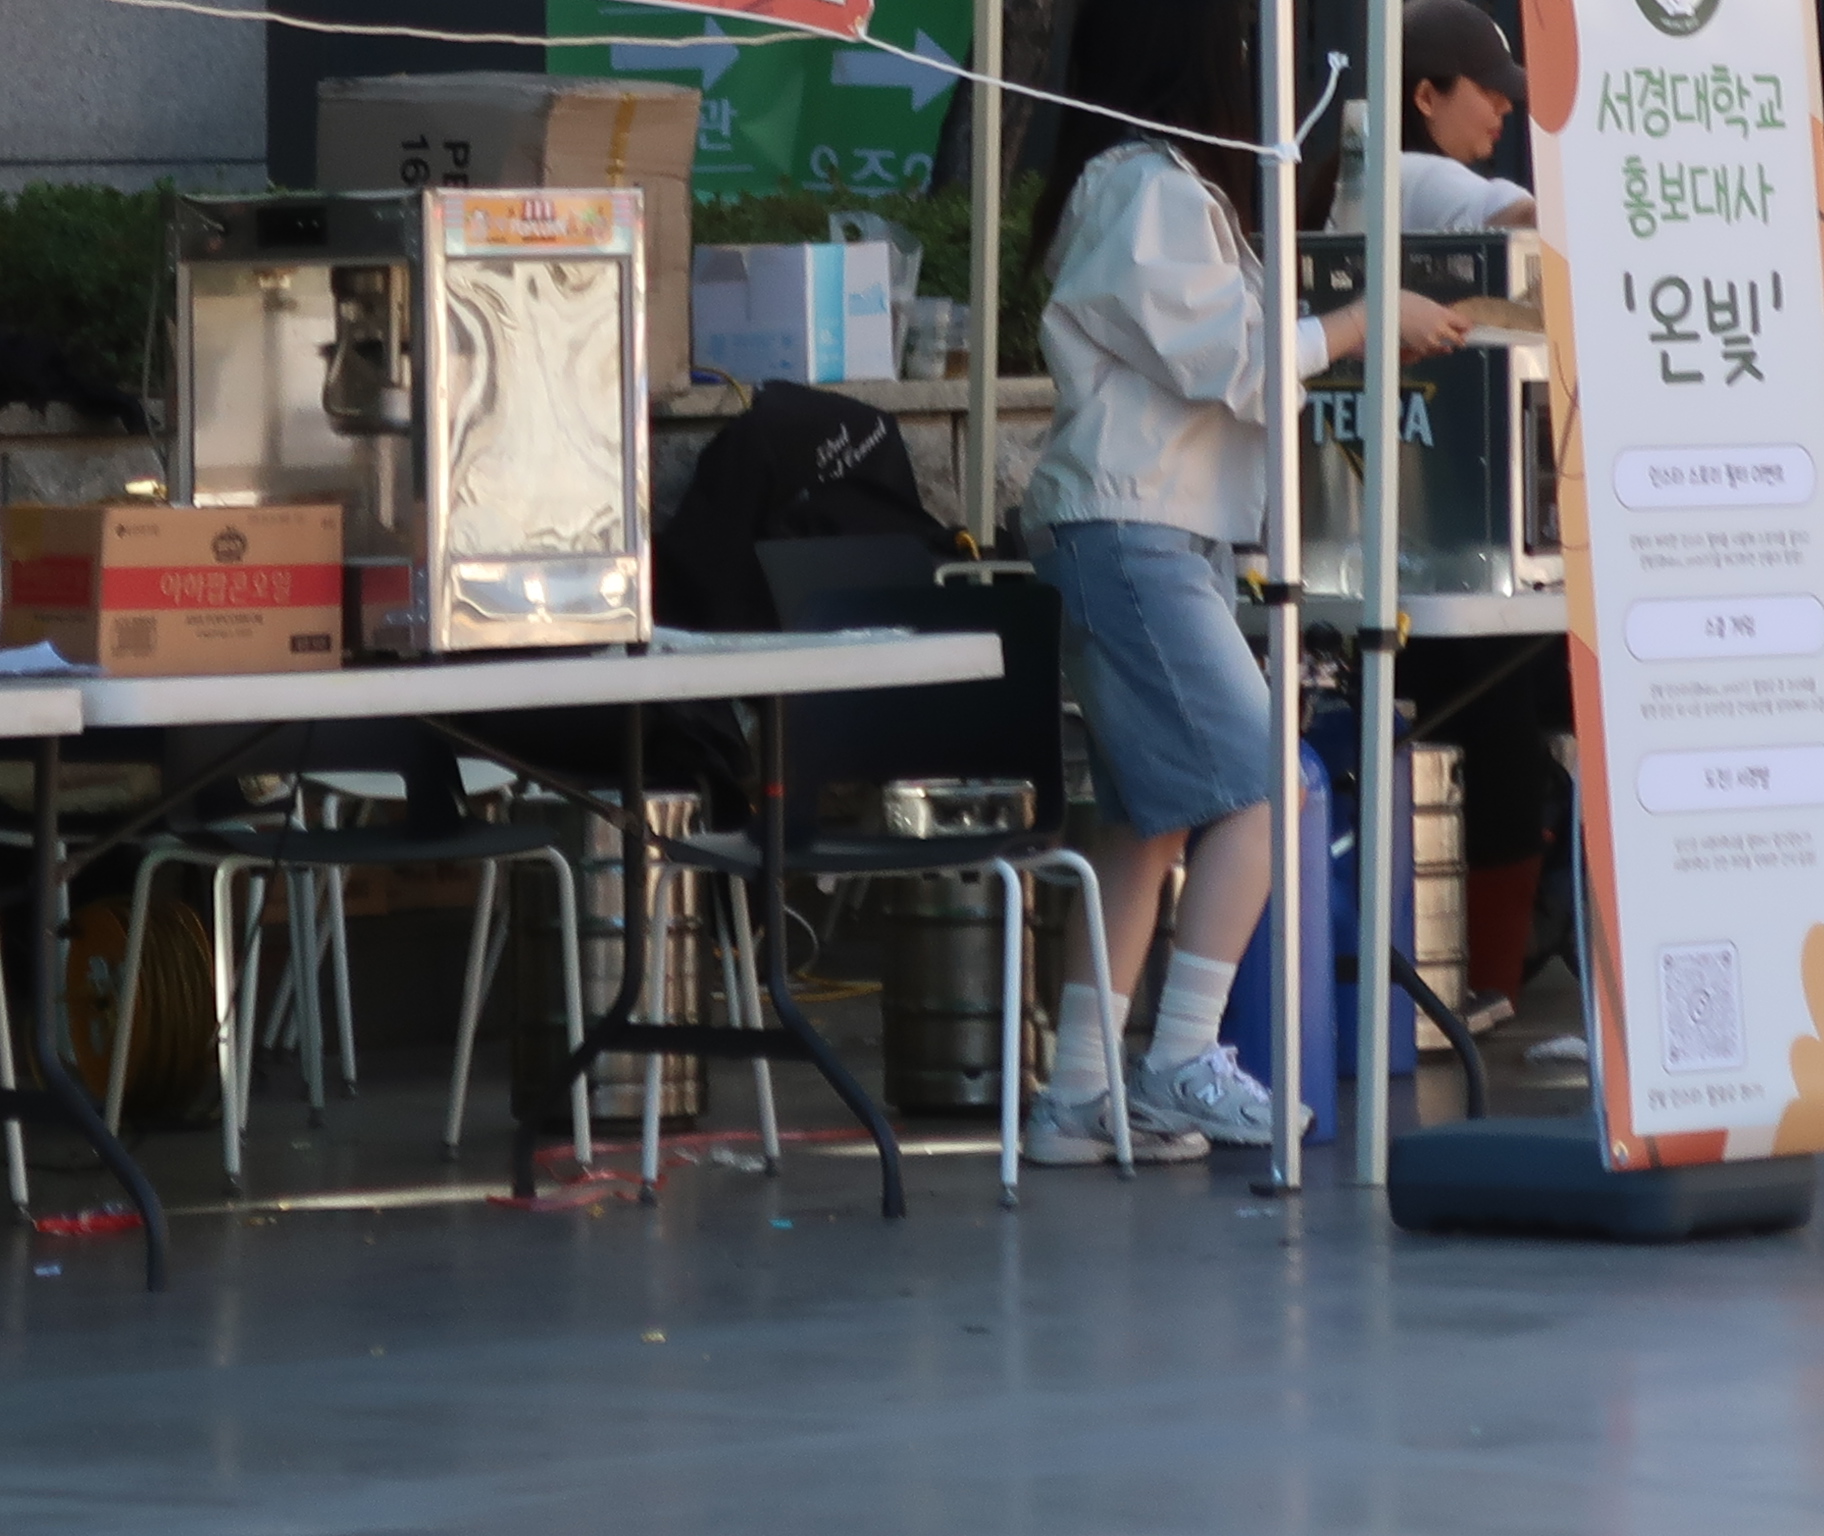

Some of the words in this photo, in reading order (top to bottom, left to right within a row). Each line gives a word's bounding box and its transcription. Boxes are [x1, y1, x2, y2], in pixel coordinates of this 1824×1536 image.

[1597, 64, 1786, 140] 서경대학교
[1622, 155, 1774, 239] 홍보대사
[1307, 391, 1434, 447] TEA
